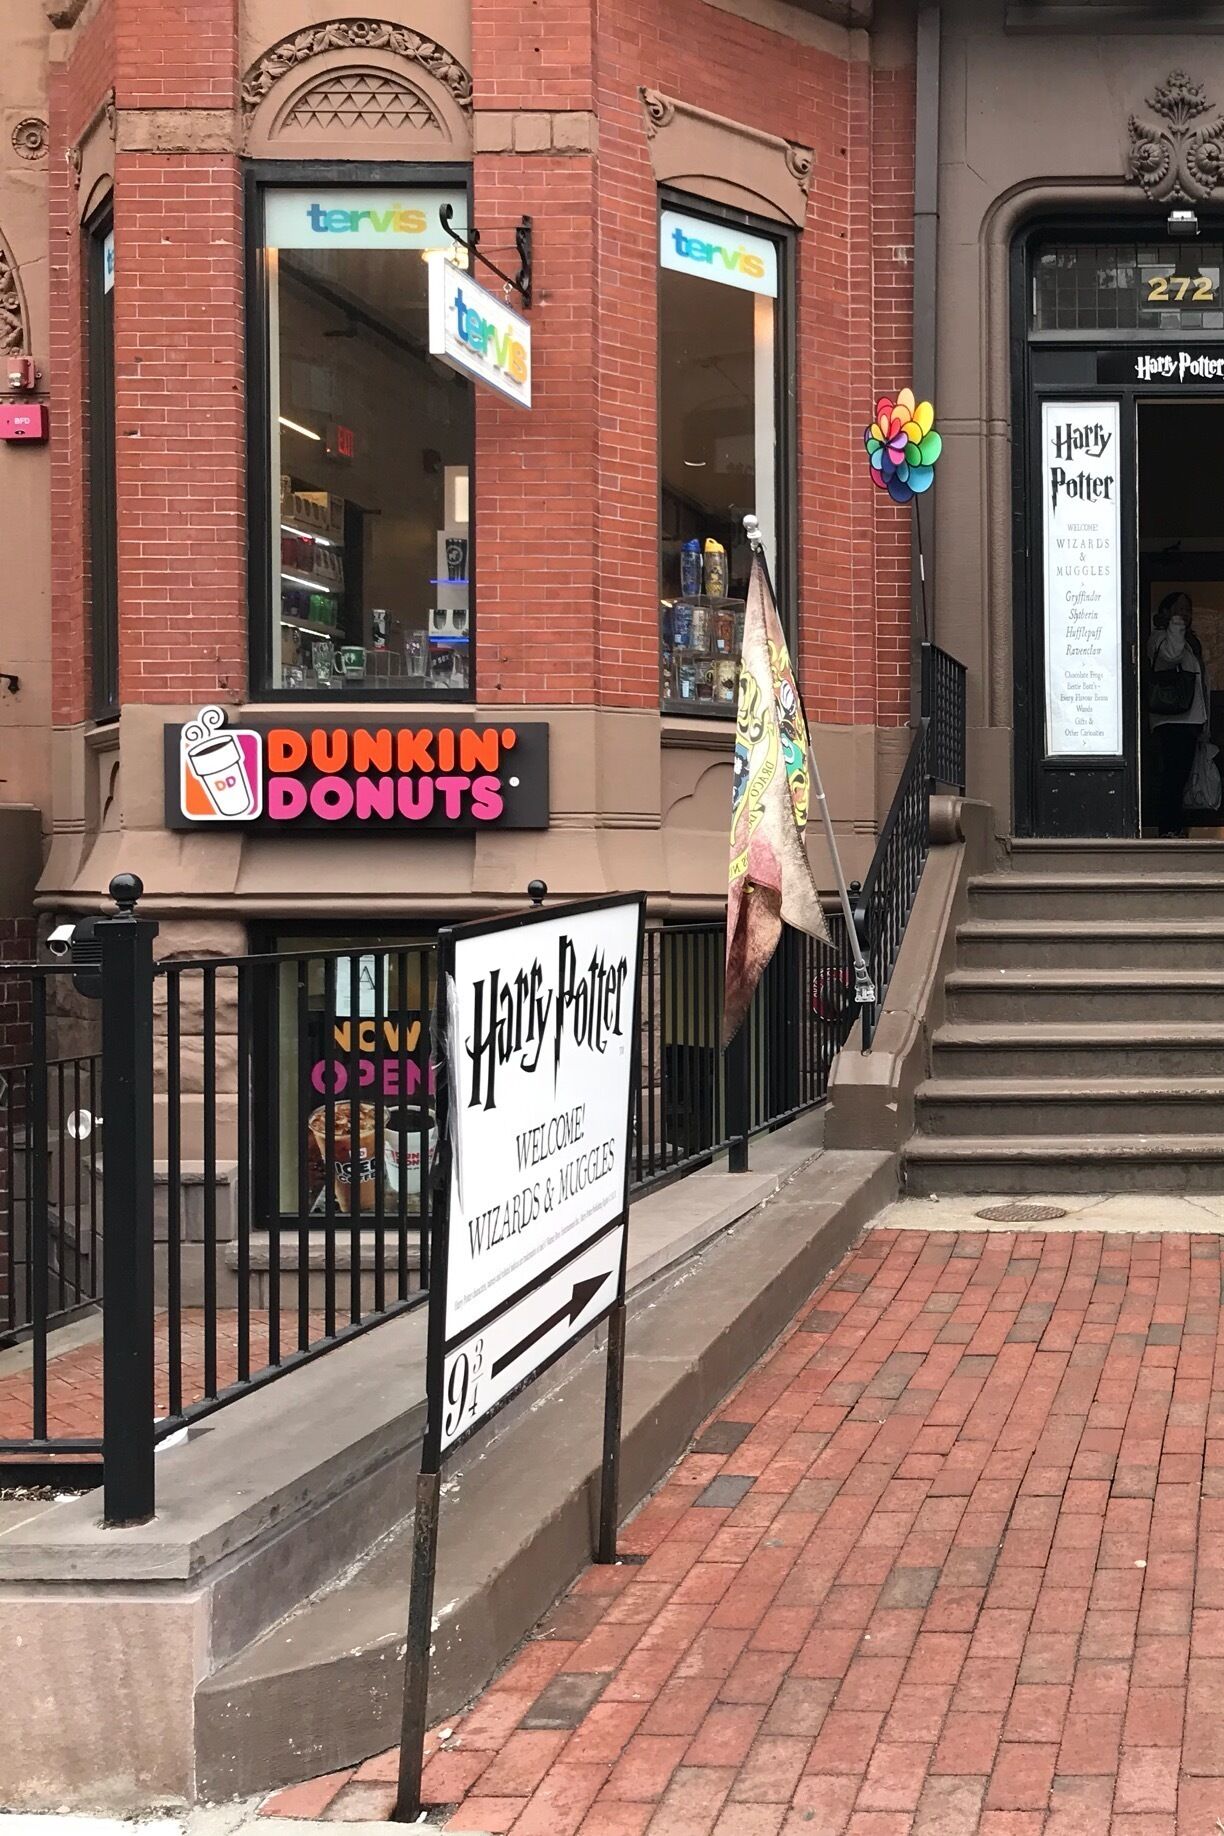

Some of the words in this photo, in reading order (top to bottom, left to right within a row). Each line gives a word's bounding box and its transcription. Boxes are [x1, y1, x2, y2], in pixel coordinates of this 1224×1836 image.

[306, 203, 428, 234] tervis
[672, 228, 765, 279] tervis
[1147, 276, 1214, 301] 272
[454, 287, 528, 385] tervis
[1134, 355, 1179, 381] Harry
[1050, 422, 1112, 461] Harry
[1050, 467, 1114, 519] Potter
[1056, 538, 1110, 550] WIZARDS
[1056, 565, 1111, 577] MUGGLES
[267, 728, 517, 773] DUNKIN'
[214, 776, 237, 792] DD
[267, 776, 505, 820] DONUTS
[333, 1020, 422, 1053] NOW
[464, 956, 553, 1112] Harry
[553, 935, 628, 1102] Potter
[311, 1059, 438, 1096] OPEN
[516, 1102, 586, 1173] WELCOME!
[468, 1182, 541, 1260] WIZARDS
[543, 1177, 555, 1214] &
[557, 1137, 616, 1205] MUGGLES
[445, 1352, 470, 1437] 9
